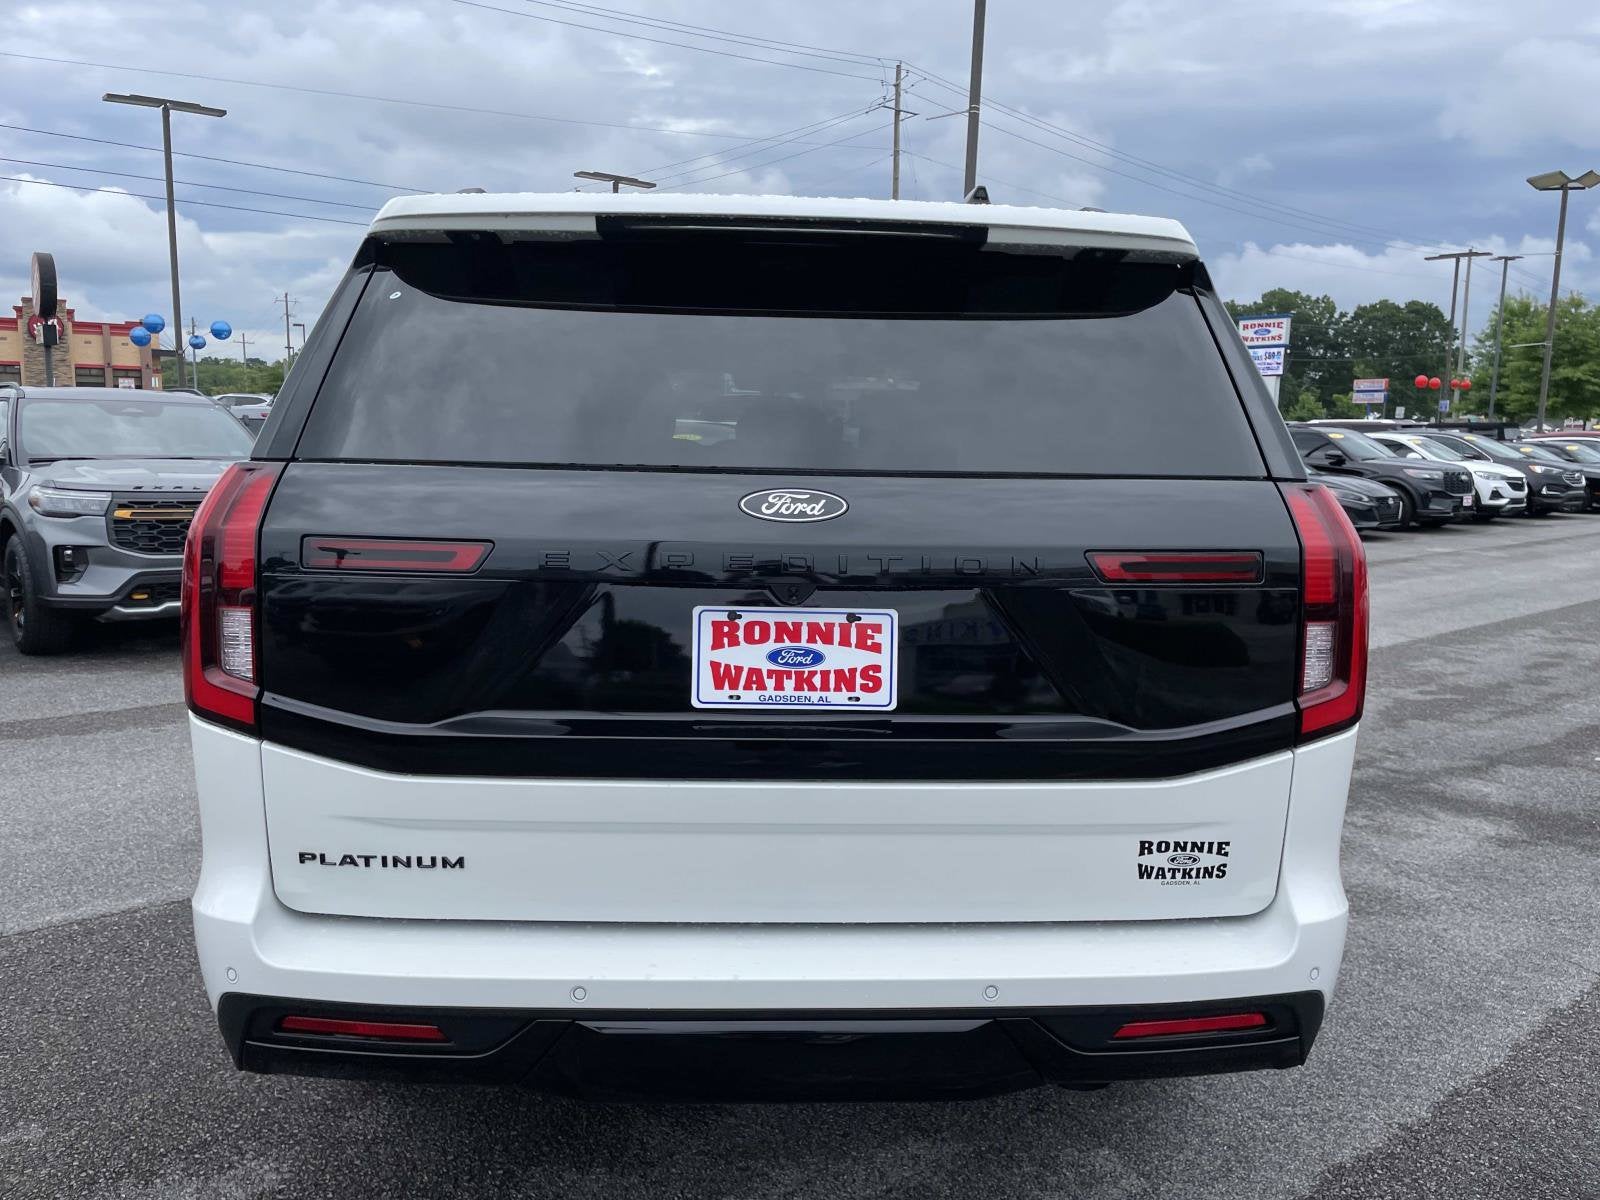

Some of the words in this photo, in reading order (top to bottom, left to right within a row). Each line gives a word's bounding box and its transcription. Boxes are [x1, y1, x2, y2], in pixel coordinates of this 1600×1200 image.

[1242, 321, 1284, 330] RONNIE
[1242, 334, 1282, 342] WATKINS
[761, 493, 826, 516] Ford
[539, 551, 1046, 576] EXPEDITION
[710, 620, 883, 655] RONNIE
[777, 650, 814, 665] Ford
[709, 659, 883, 694] WATKINS
[758, 694, 815, 704] GADSDEN,
[817, 695, 832, 704] AL
[1138, 840, 1231, 857] RONNIE
[298, 851, 465, 869] PLATINUM
[1137, 863, 1227, 879] WATKINS
